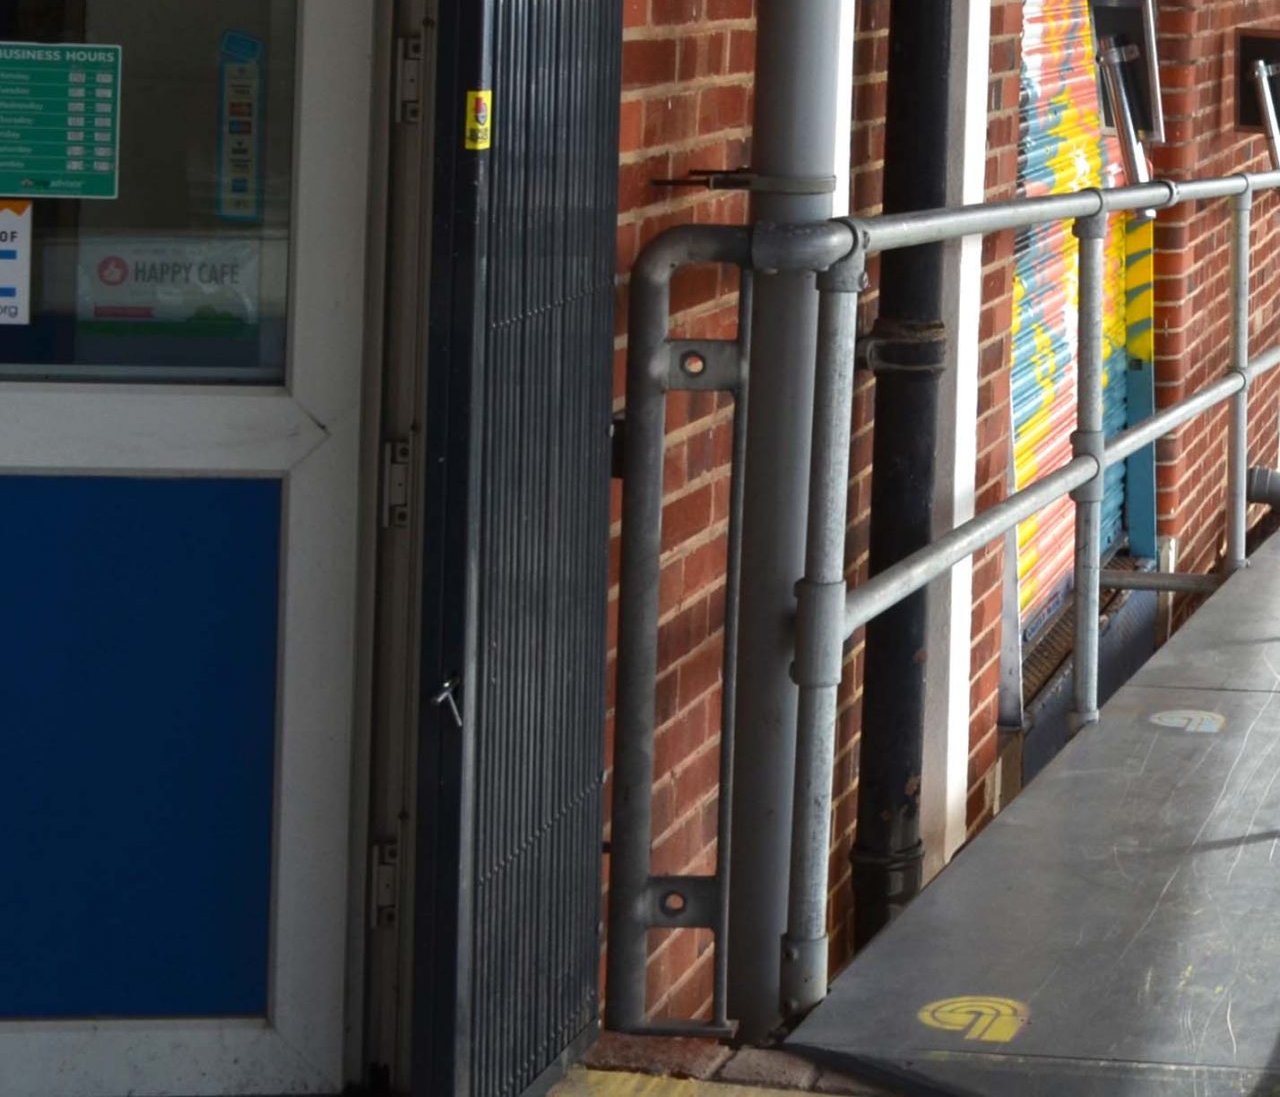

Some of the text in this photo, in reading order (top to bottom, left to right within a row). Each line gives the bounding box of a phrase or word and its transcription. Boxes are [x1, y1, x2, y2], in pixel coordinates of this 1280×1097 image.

[0, 49, 115, 63] USINESS HOURS
[134, 261, 193, 284] HAPPY
